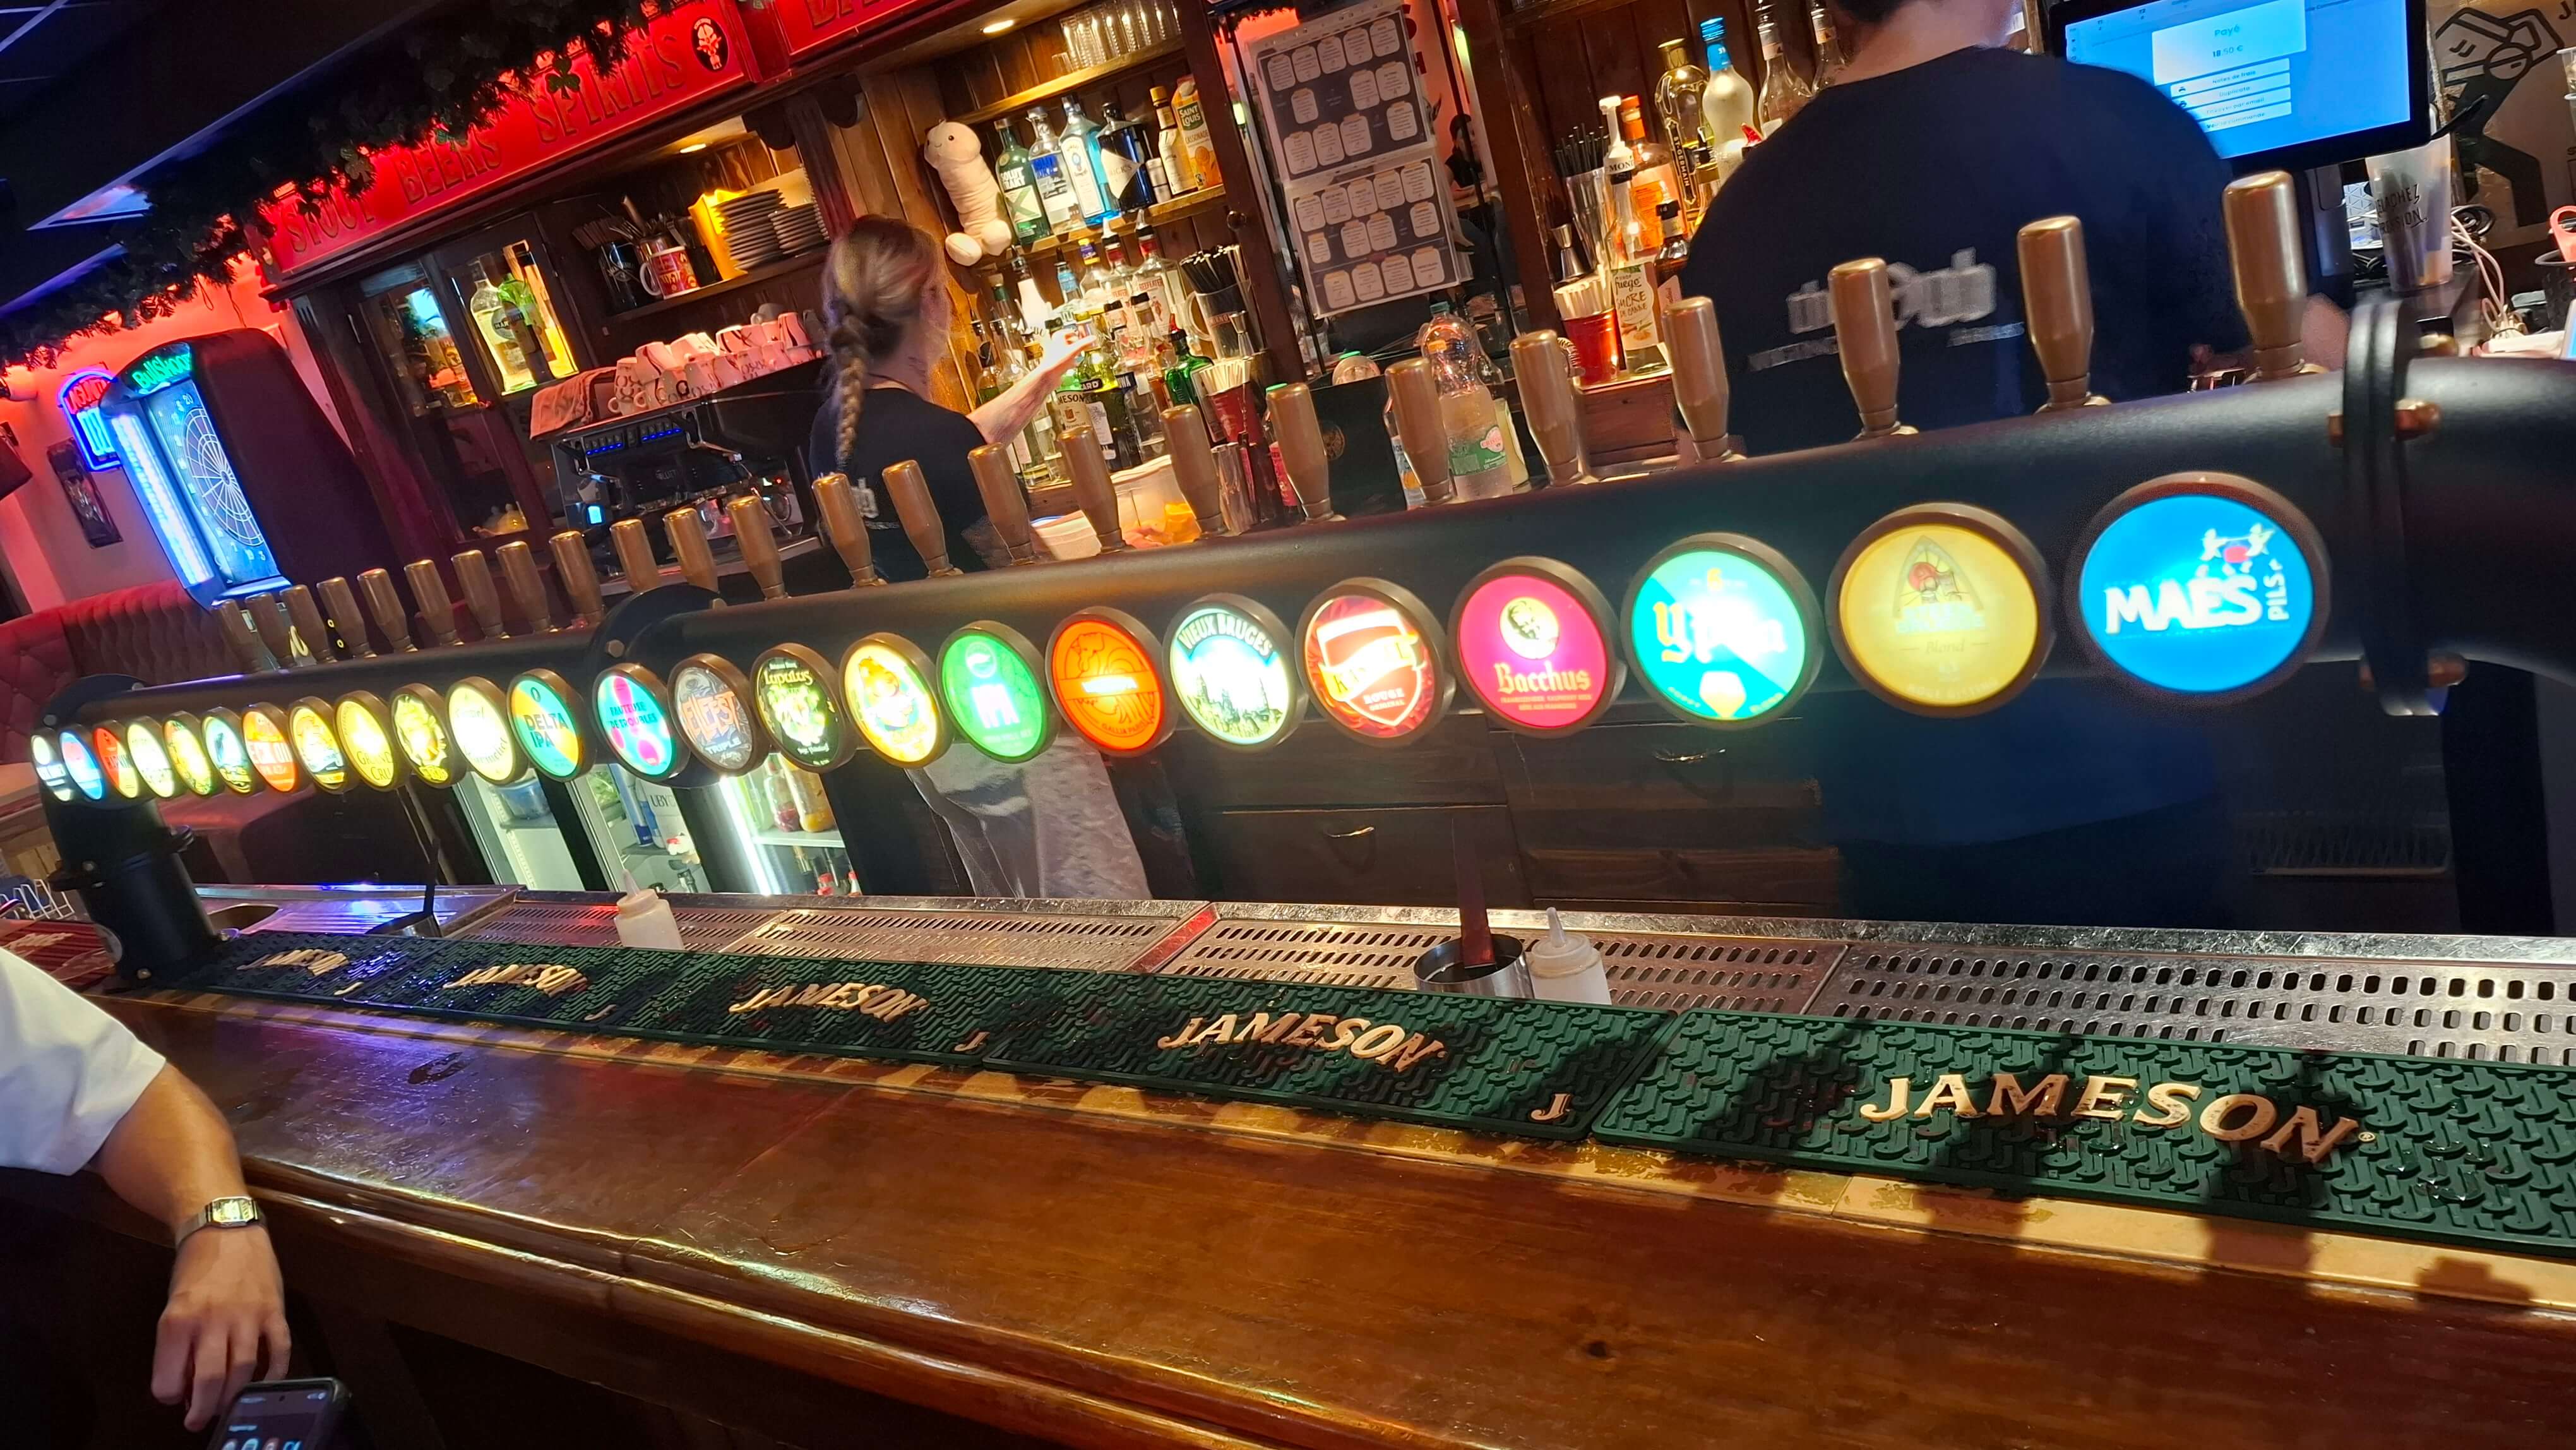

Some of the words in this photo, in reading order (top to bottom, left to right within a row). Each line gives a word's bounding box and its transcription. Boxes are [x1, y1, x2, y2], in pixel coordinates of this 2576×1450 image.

[2214, 24, 2241, 37] Payé
[2212, 47, 2234, 58] 18.50
[2449, 39, 2477, 57] JJ
[393, 126, 503, 205] BEERS
[529, 32, 686, 143] SPIRITS
[1180, 104, 1199, 118] SAINT
[1182, 115, 1201, 127] LOUIS
[1673, 136, 1690, 188] ST-GERMAIN
[182, 393, 194, 405] 20
[2104, 573, 2263, 634] MAES
[2262, 572, 2290, 621] PILS
[1178, 614, 1216, 650] VIEUX
[1216, 613, 1273, 658] BRUGES
[1493, 659, 1594, 695] Bacchus
[1363, 687, 1405, 705] ROUGE
[523, 712, 569, 731] DELTA
[530, 731, 555, 748] IPA
[705, 736, 742, 755] TRIPLE
[356, 751, 391, 765] GRND
[370, 766, 391, 781] CRU
[442, 964, 588, 998] JAMESON
[729, 982, 931, 1023] JAMESON
[1157, 1012, 1446, 1073] JAMESON
[1530, 1093, 1574, 1122] J
[1859, 1074, 2363, 1166] JAMESON
